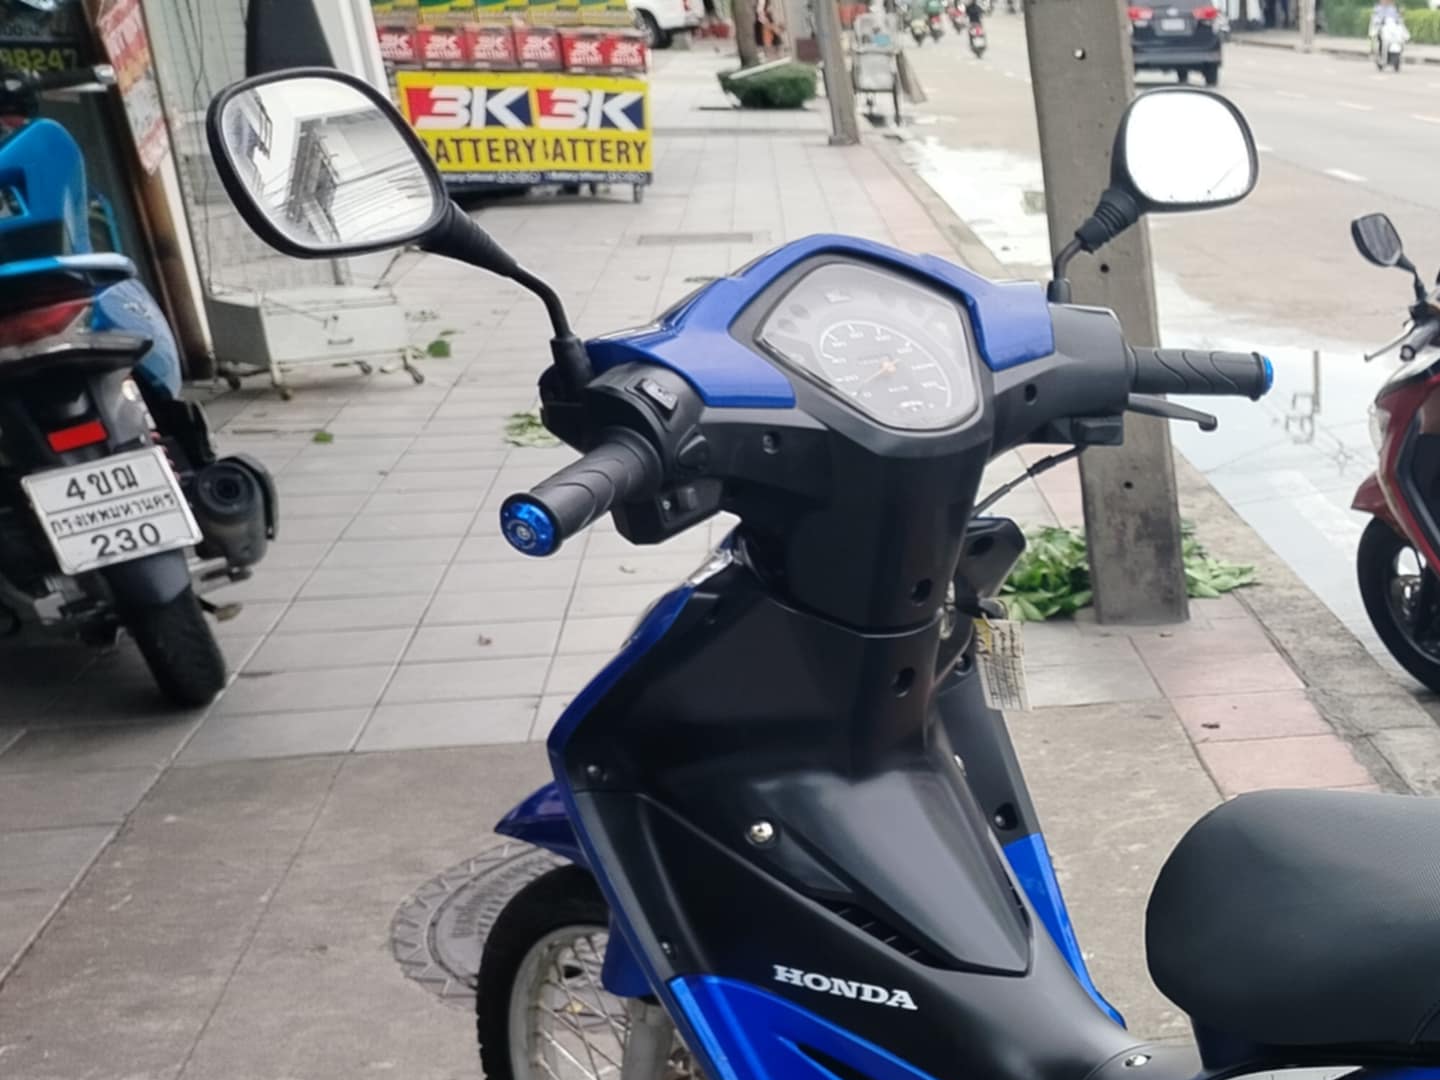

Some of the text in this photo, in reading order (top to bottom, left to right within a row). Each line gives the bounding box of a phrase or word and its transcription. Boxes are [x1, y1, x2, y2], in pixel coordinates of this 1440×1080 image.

[414, 86, 643, 132] 3K 3K
[424, 136, 647, 165] ATTERY ATTERY
[91, 522, 161, 558] 230
[772, 964, 918, 1011] HONDA
